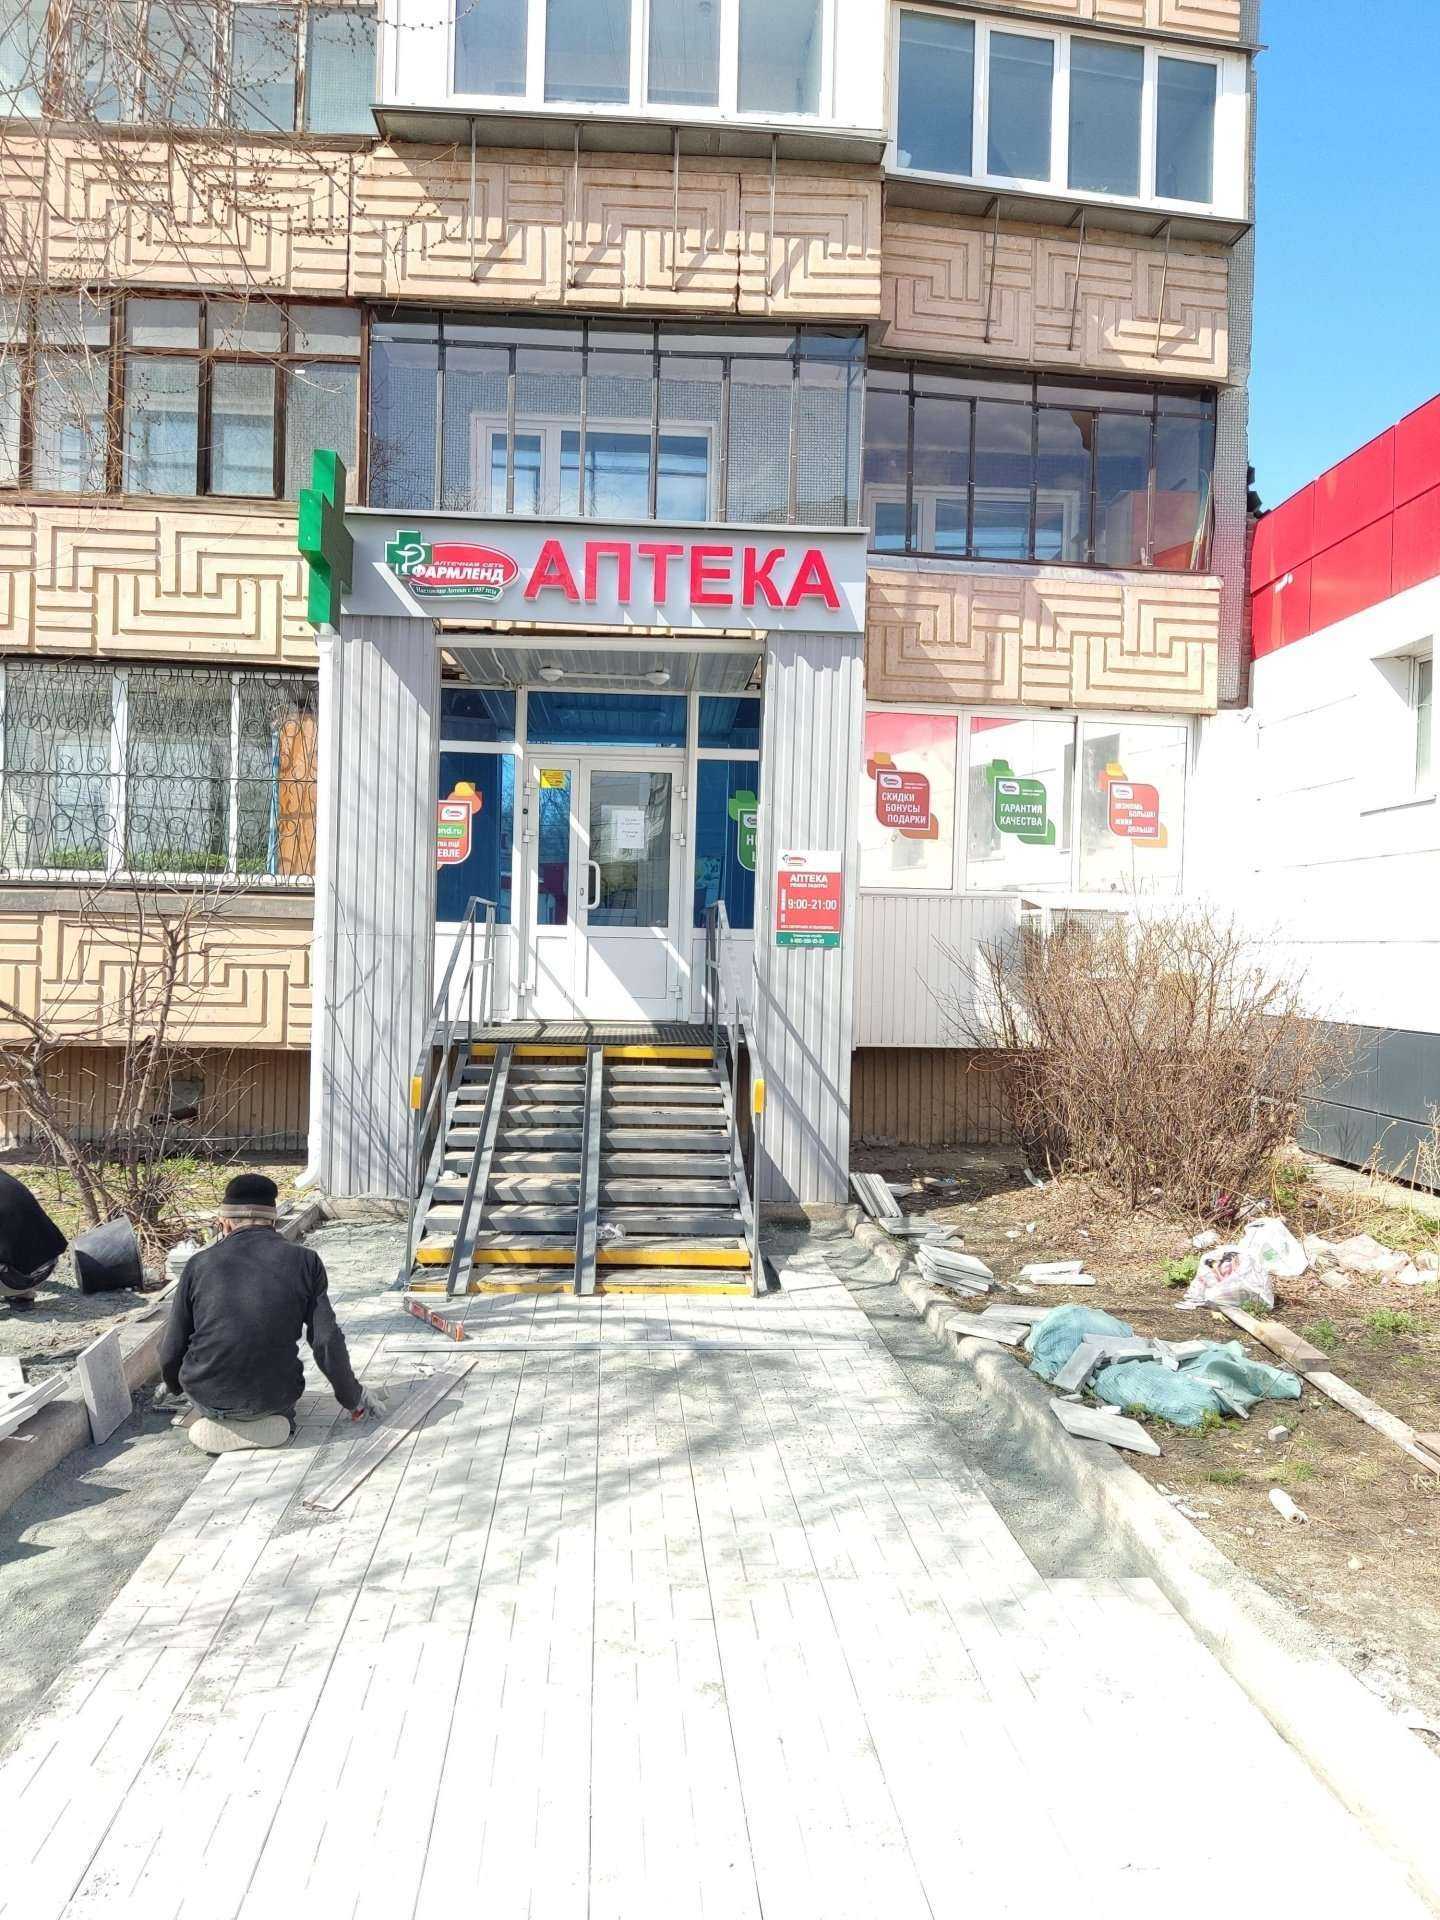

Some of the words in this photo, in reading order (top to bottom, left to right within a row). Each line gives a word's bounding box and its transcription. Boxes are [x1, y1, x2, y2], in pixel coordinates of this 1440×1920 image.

[412, 564, 504, 584] ФАРМЛЕНД
[523, 539, 841, 609] АПТЕКА
[881, 791, 915, 802] СКИДКИ
[885, 803, 921, 813] БОНУСЫ
[1000, 803, 1043, 814] ГАРАНТИЯ
[887, 814, 927, 825] ПОДАРКИ
[1000, 815, 1043, 826] КАЧЕСТВА
[789, 874, 829, 883] АПТЕКА
[787, 898, 838, 911] 9:00-21:00
